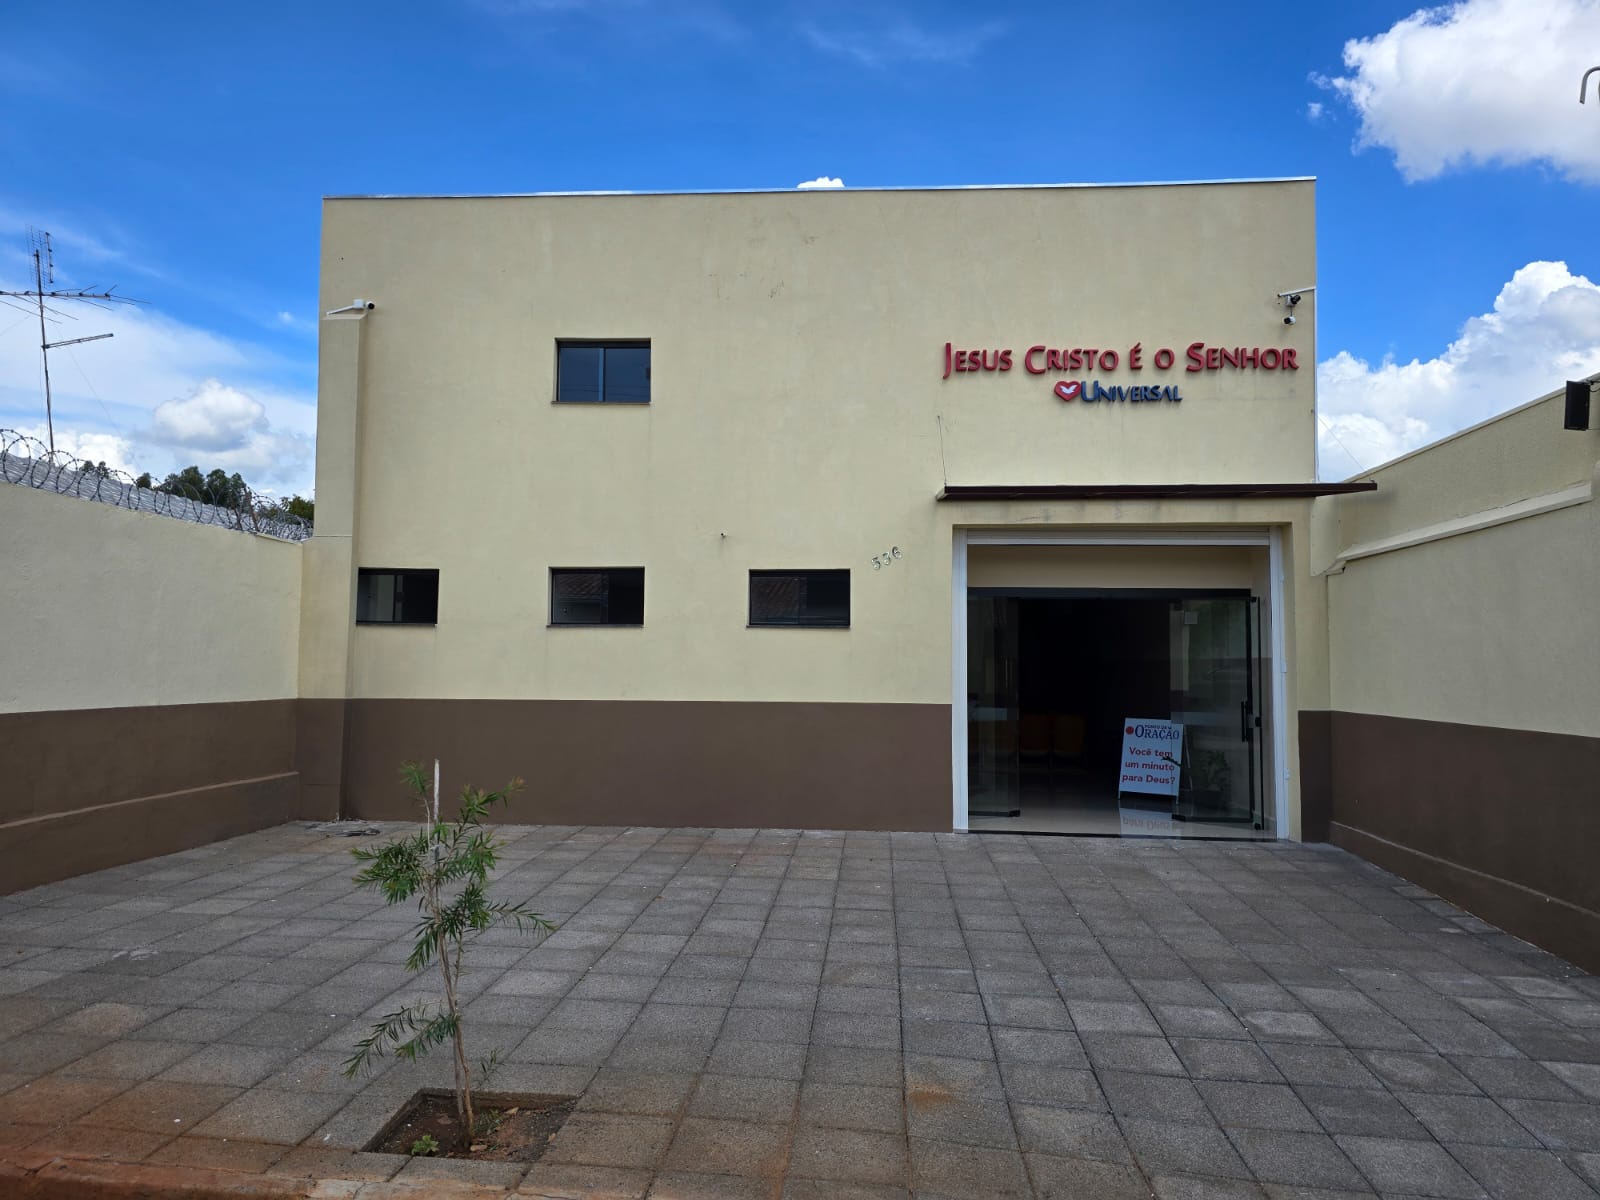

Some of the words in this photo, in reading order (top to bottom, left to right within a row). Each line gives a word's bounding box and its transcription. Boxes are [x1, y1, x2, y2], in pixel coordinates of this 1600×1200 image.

[943, 343, 1013, 379] JESUS
[1025, 345, 1119, 374] CRISTO
[1130, 343, 1143, 370] É
[1154, 349, 1175, 370] O
[1186, 343, 1299, 372] SENHOR
[1081, 380, 1183, 402] UNIVERSAL
[1134, 724, 1180, 741] ORAÇÃO
[1129, 746, 1152, 756] Você
[1154, 749, 1173, 758] tem
[1125, 761, 1139, 769] um
[1142, 761, 1175, 771] minuto
[1122, 774, 1143, 783] para
[1146, 774, 1176, 785] Deus?
